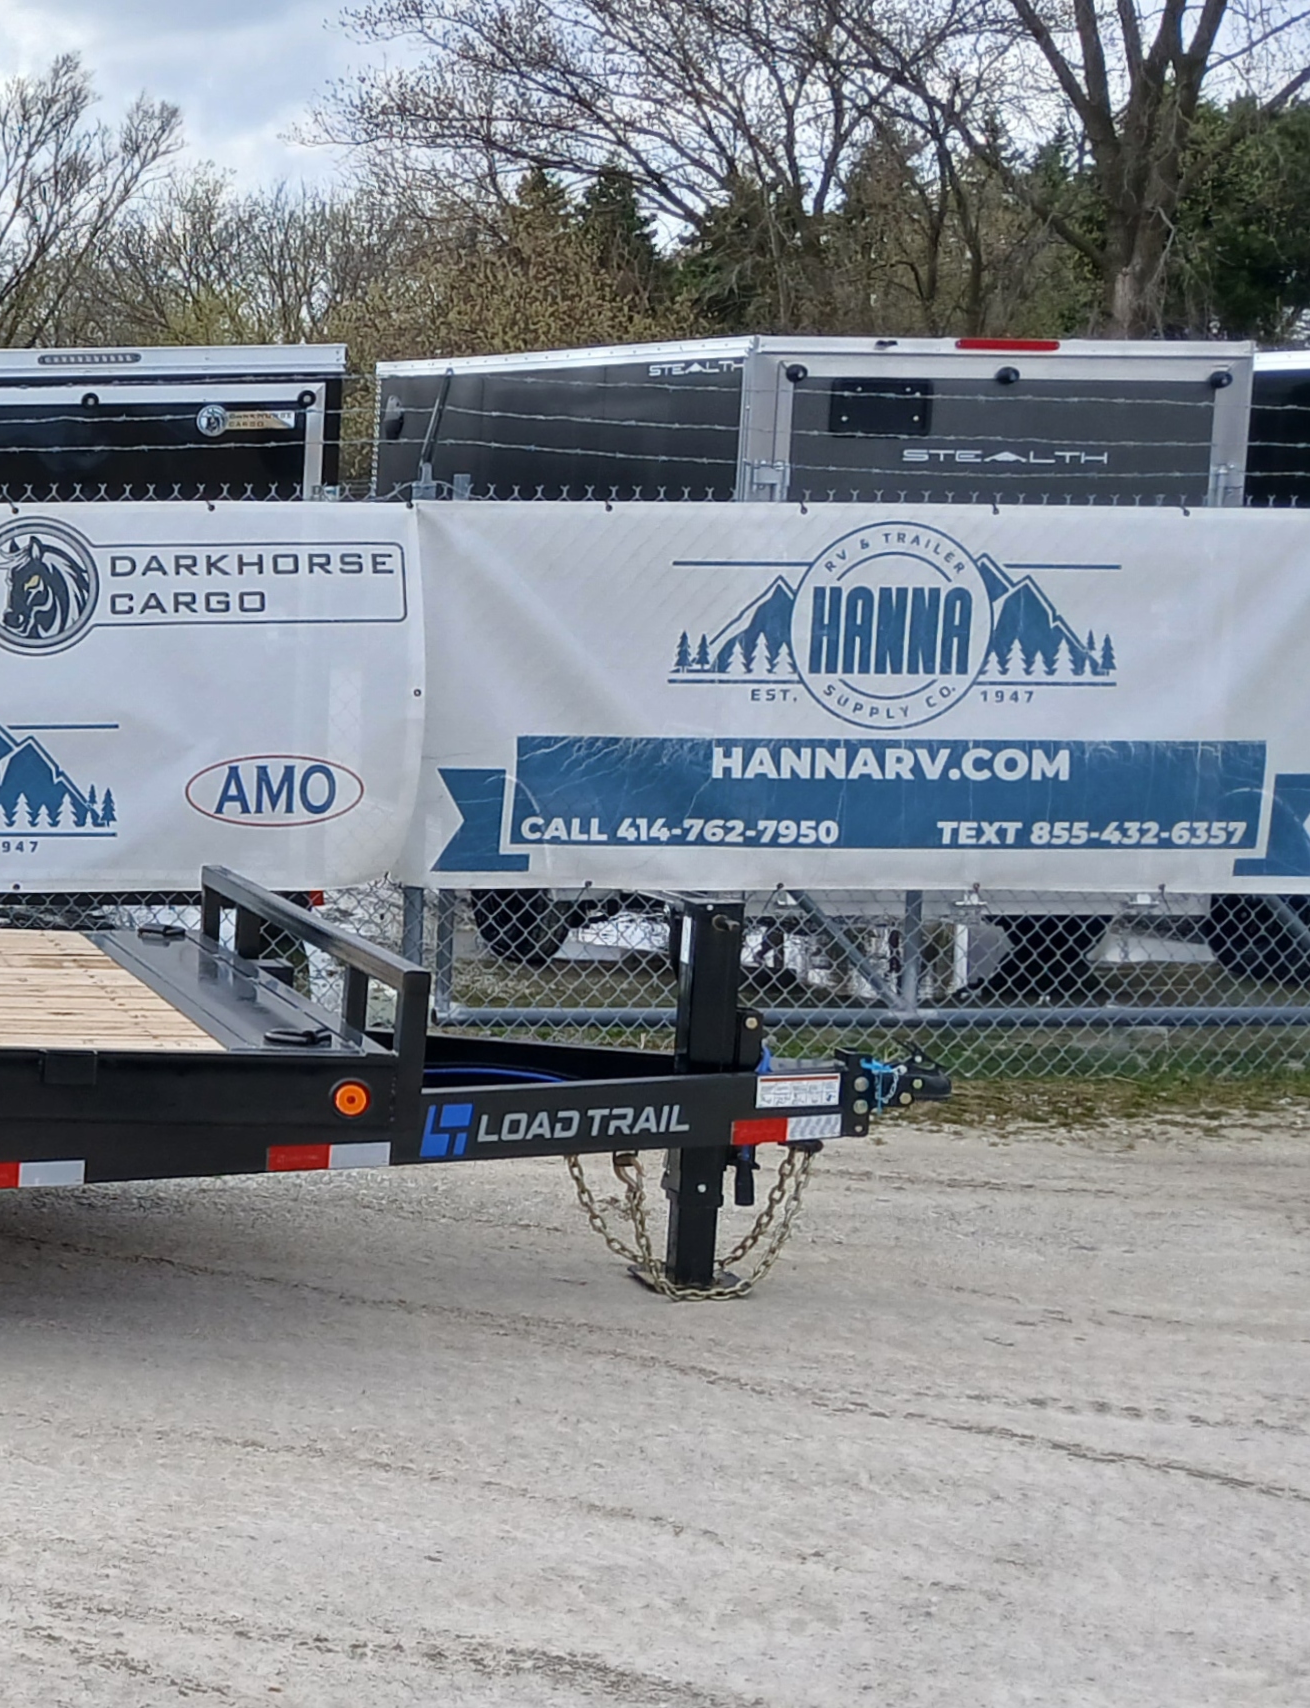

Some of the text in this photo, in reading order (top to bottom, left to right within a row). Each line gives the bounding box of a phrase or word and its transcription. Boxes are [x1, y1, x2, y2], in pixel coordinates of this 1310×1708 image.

[902, 449, 1108, 465] STEALTH
[110, 553, 396, 577] DARKHORSE
[825, 550, 848, 572] RV
[882, 532, 965, 574] TRAILER
[110, 591, 266, 615] CARGO
[808, 586, 972, 675] HANNA
[750, 688, 797, 703] EST.
[822, 684, 910, 719] SUPPLY
[980, 690, 1034, 703] 1947
[712, 747, 1070, 781] HANNARV.COM
[215, 764, 336, 815] AMO
[521, 817, 839, 844] CALL 414-762-7950
[937, 821, 1247, 845] TEXT 855-432-6357
[477, 1110, 580, 1142] LOAD
[587, 1104, 690, 1137] TRAIL
